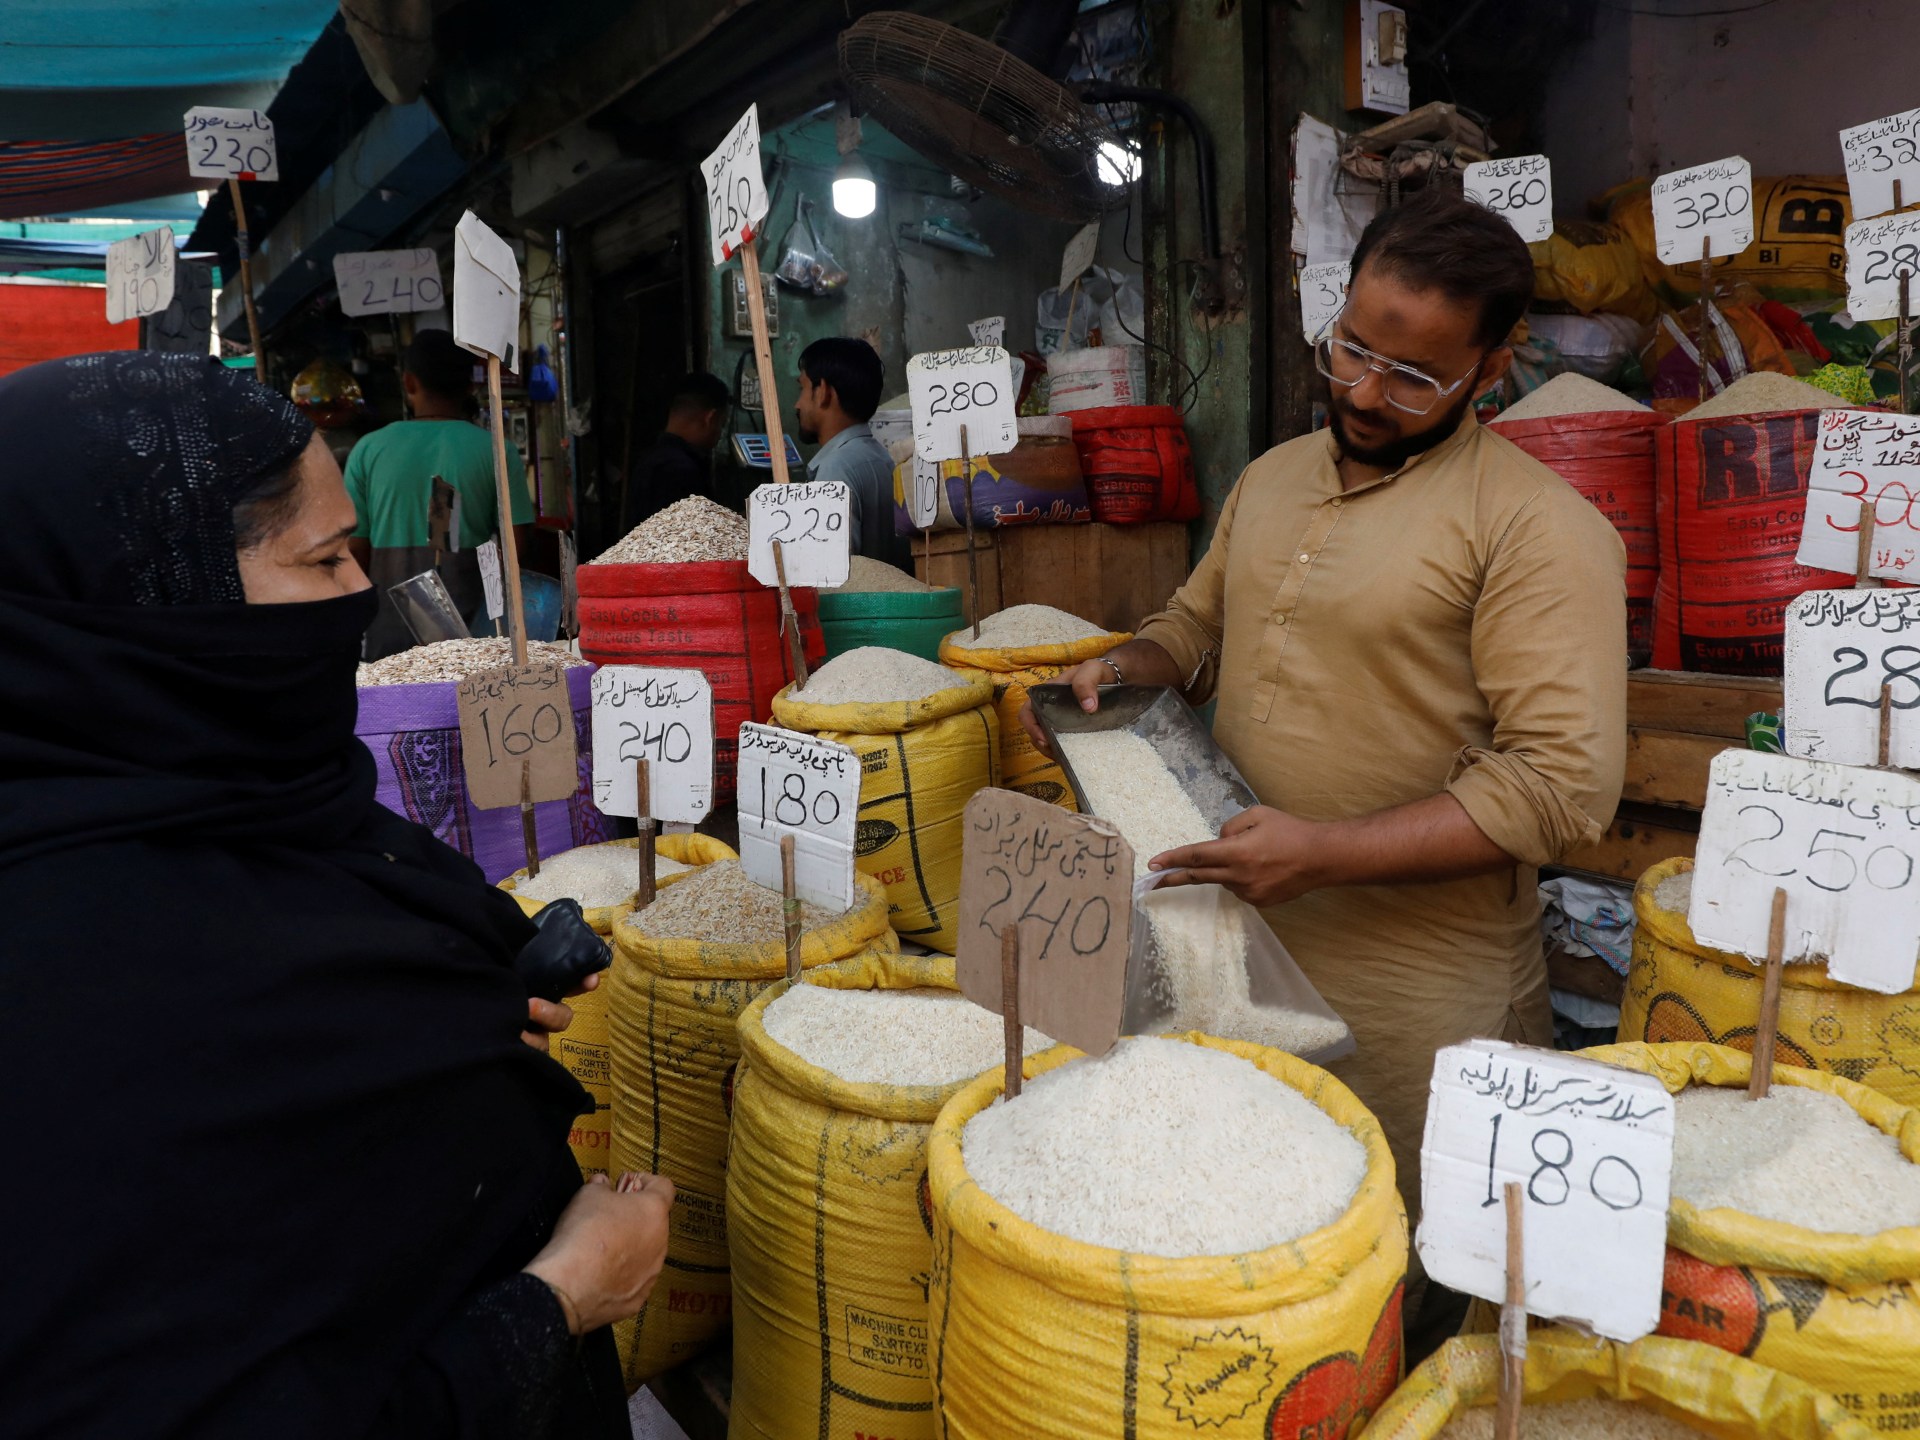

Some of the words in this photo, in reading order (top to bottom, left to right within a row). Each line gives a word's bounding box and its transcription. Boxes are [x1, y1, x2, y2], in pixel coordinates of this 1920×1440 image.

[199, 135, 272, 174] 230
[714, 169, 751, 239] 260
[1487, 178, 1546, 211] 260
[1674, 185, 1749, 229] 320
[1865, 244, 1920, 284] 28
[362, 277, 442, 313] 240
[929, 382, 998, 417] 280
[767, 507, 842, 544] 220
[1727, 512, 1769, 532] Easy
[1775, 508, 1805, 524] Coo
[620, 607, 660, 623] Cook
[648, 629, 694, 644] Taste
[1696, 643, 1744, 660] Every
[479, 703, 561, 768] 160
[619, 721, 692, 764] 240
[761, 767, 840, 829] 180
[1722, 805, 1914, 892] 250
[979, 865, 1111, 960] 240
[563, 1044, 601, 1059] MACHINE
[571, 1067, 598, 1079] READY
[1481, 1113, 1643, 1211] 180
[674, 1193, 714, 1211] MACHINE
[851, 1312, 905, 1338] MACHINE
[862, 1347, 902, 1367] READY
[907, 1356, 923, 1370] TO
